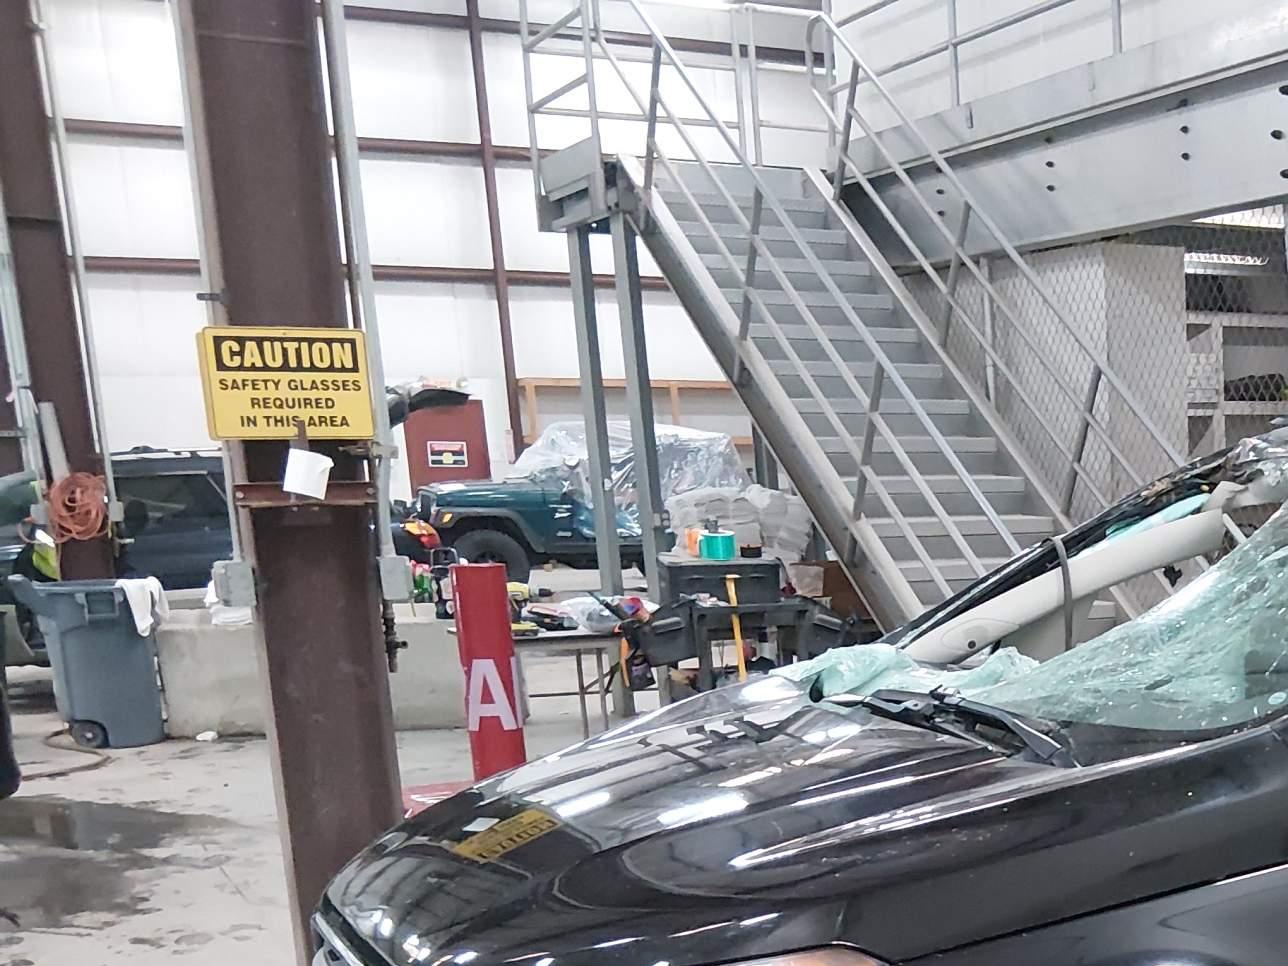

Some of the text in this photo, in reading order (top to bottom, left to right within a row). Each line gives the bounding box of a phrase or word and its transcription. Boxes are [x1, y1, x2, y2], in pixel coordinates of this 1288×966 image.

[220, 340, 354, 369] CAUTION
[219, 378, 362, 392] SAFETY GLASSES
[250, 397, 336, 409] REQUIRED
[240, 415, 350, 428] IN THIS AREA
